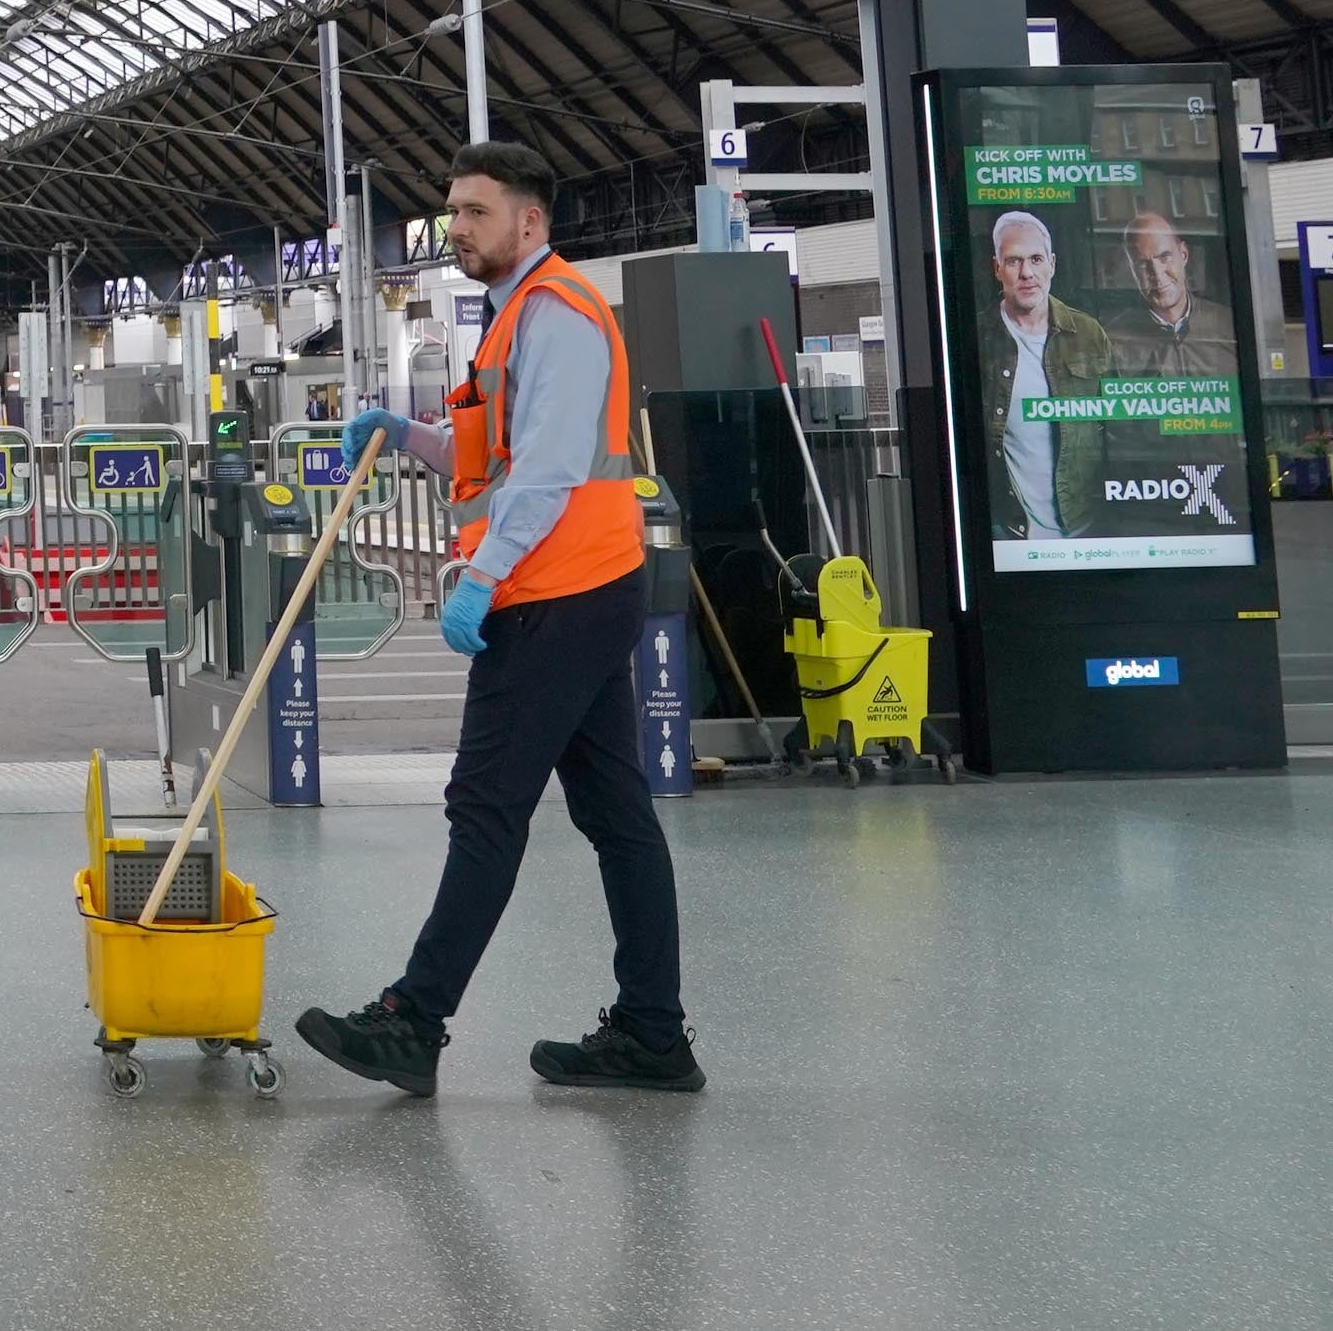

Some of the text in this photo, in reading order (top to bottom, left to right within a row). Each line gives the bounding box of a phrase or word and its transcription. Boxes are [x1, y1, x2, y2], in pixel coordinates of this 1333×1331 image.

[720, 131, 735, 155] 6
[1250, 127, 1263, 149] 7
[974, 148, 1086, 163] KICK OFF WITH
[976, 164, 1137, 185] CHRIS MOYLES
[978, 187, 1071, 201] FROM 6:30AM
[1104, 379, 1229, 394] CLOCK OFF WITH
[1026, 396, 1231, 418] JOHNNY VAUGHAN
[1163, 418, 1206, 431] FROM
[1104, 479, 1190, 501] RADIO
[1105, 659, 1161, 685] global
[646, 700, 665, 708] keep
[867, 705, 908, 714] CAUTION
[866, 713, 909, 722] WET FLOOR
